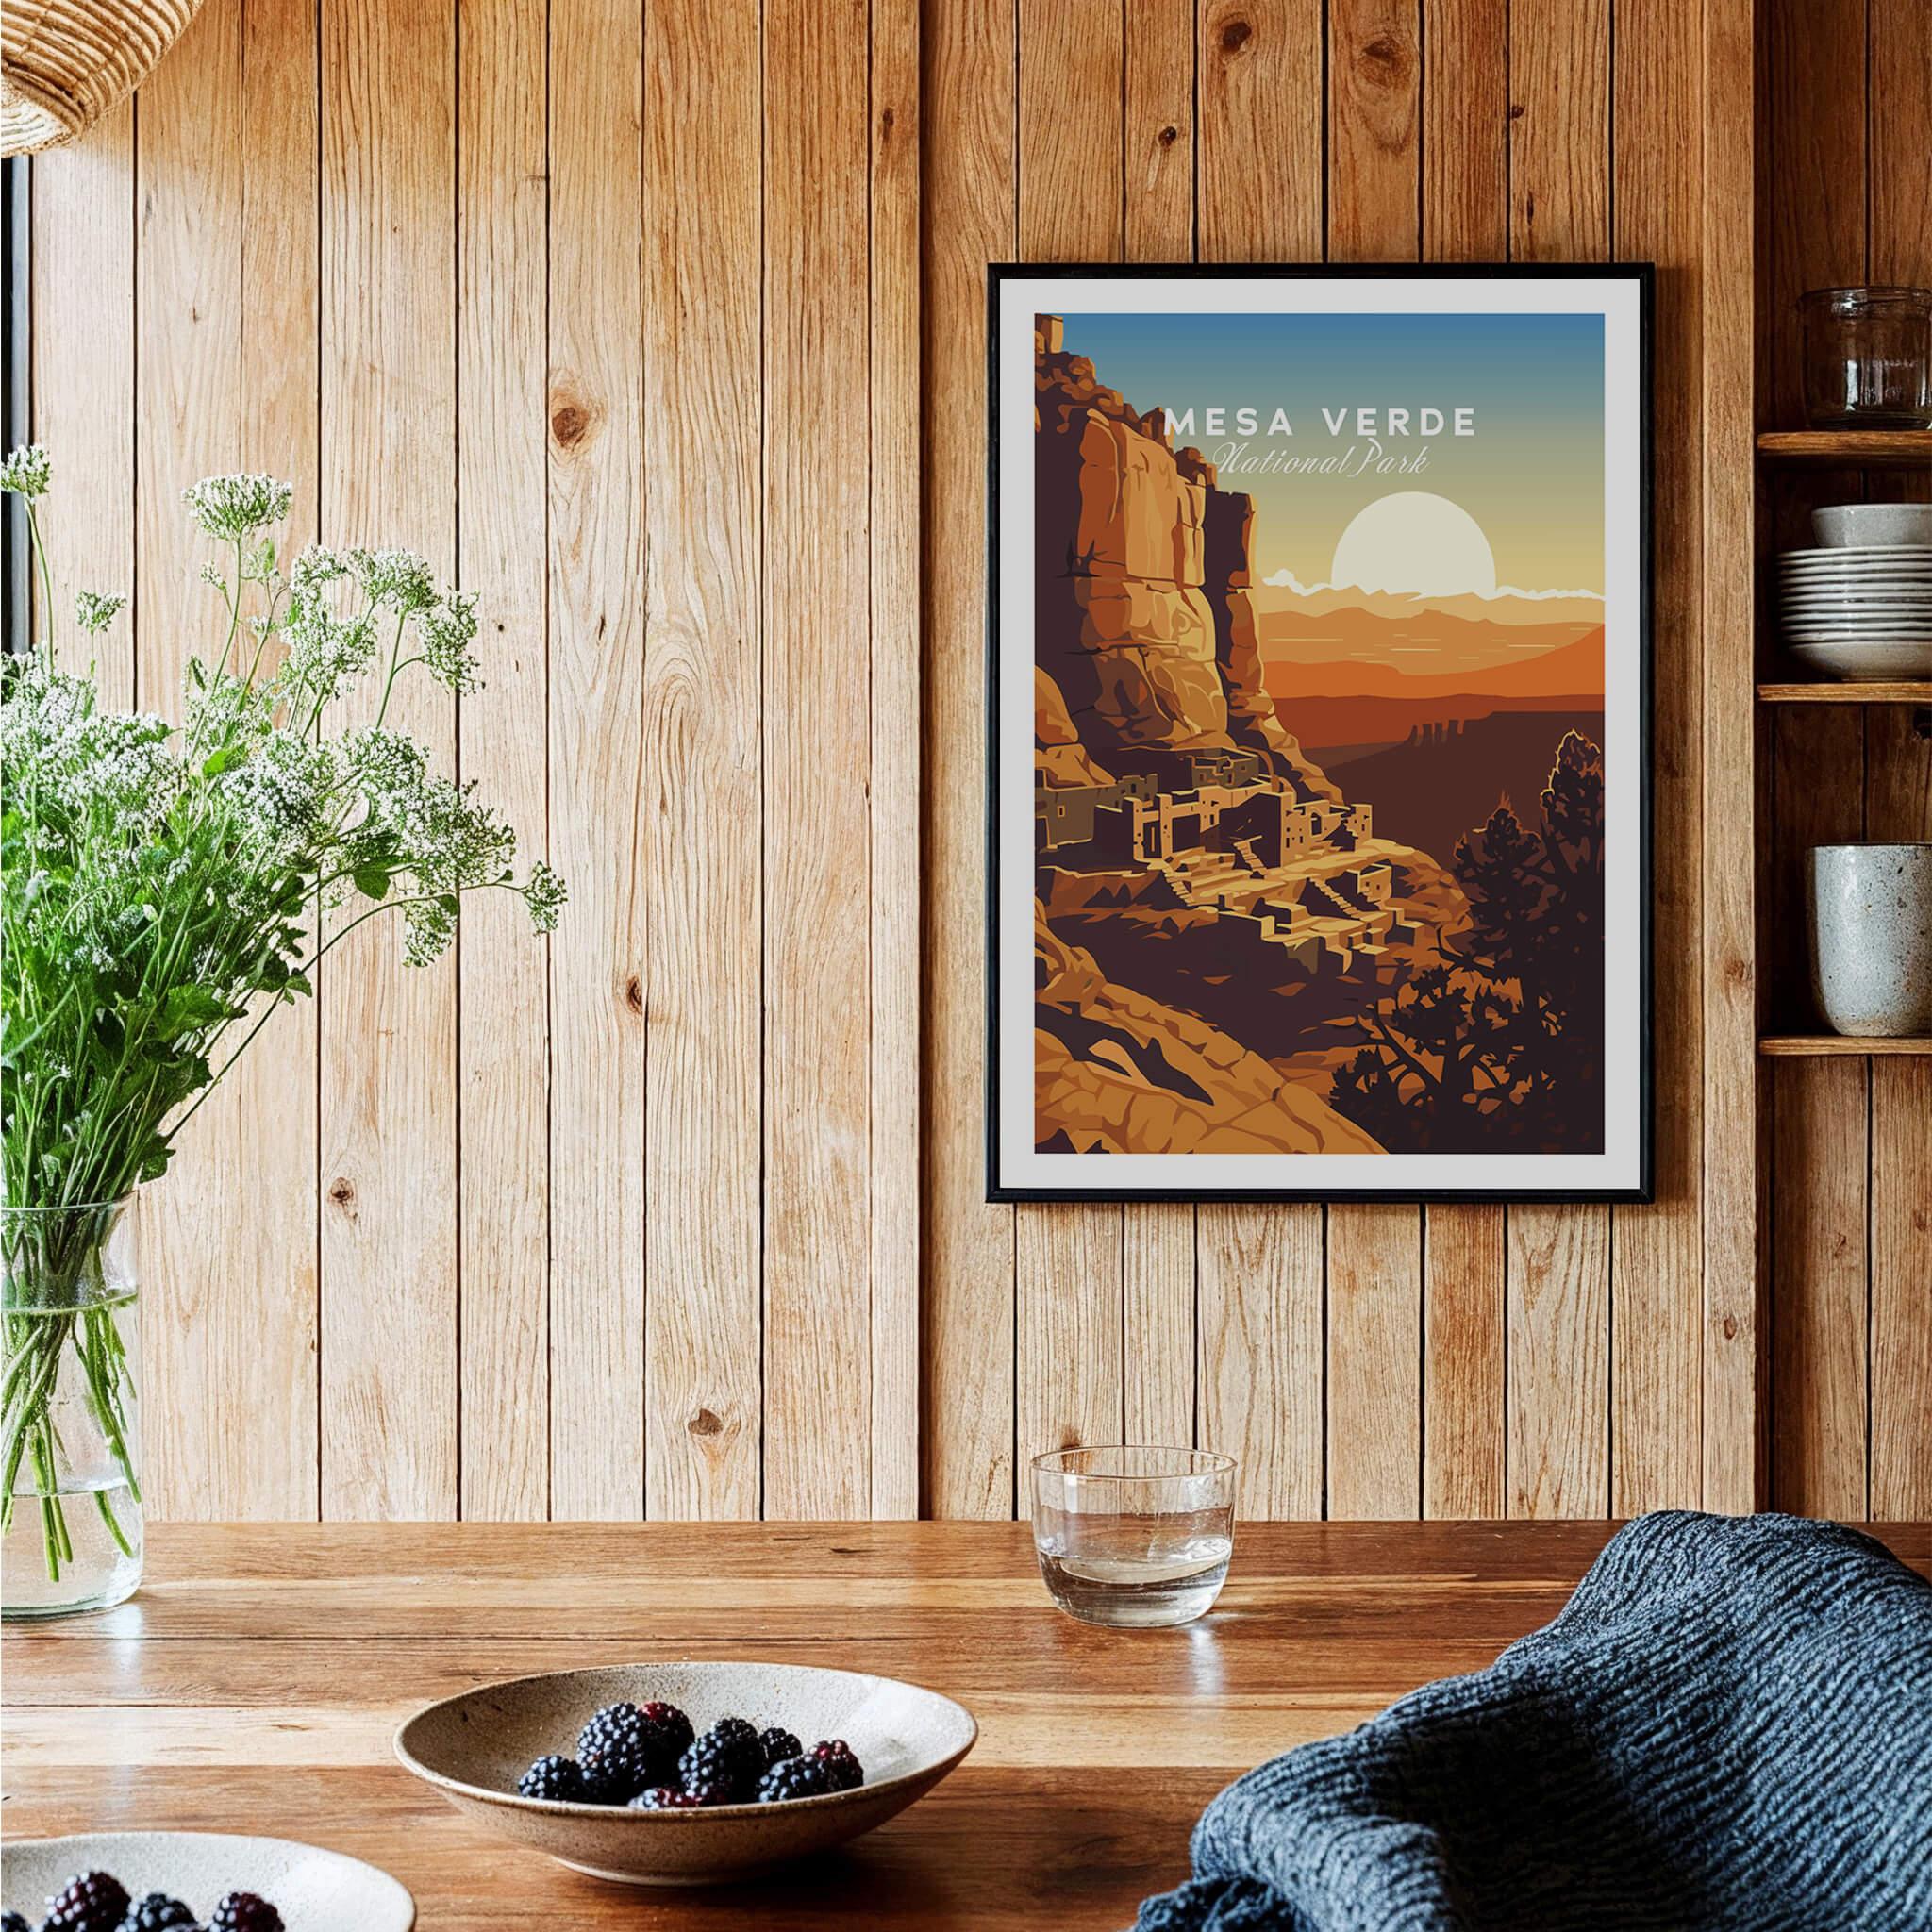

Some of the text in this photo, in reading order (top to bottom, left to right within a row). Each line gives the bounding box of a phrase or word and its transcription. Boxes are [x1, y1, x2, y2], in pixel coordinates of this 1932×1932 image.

[1163, 408, 1475, 436] MESA VERDE
[1212, 438, 1431, 478] National Park
